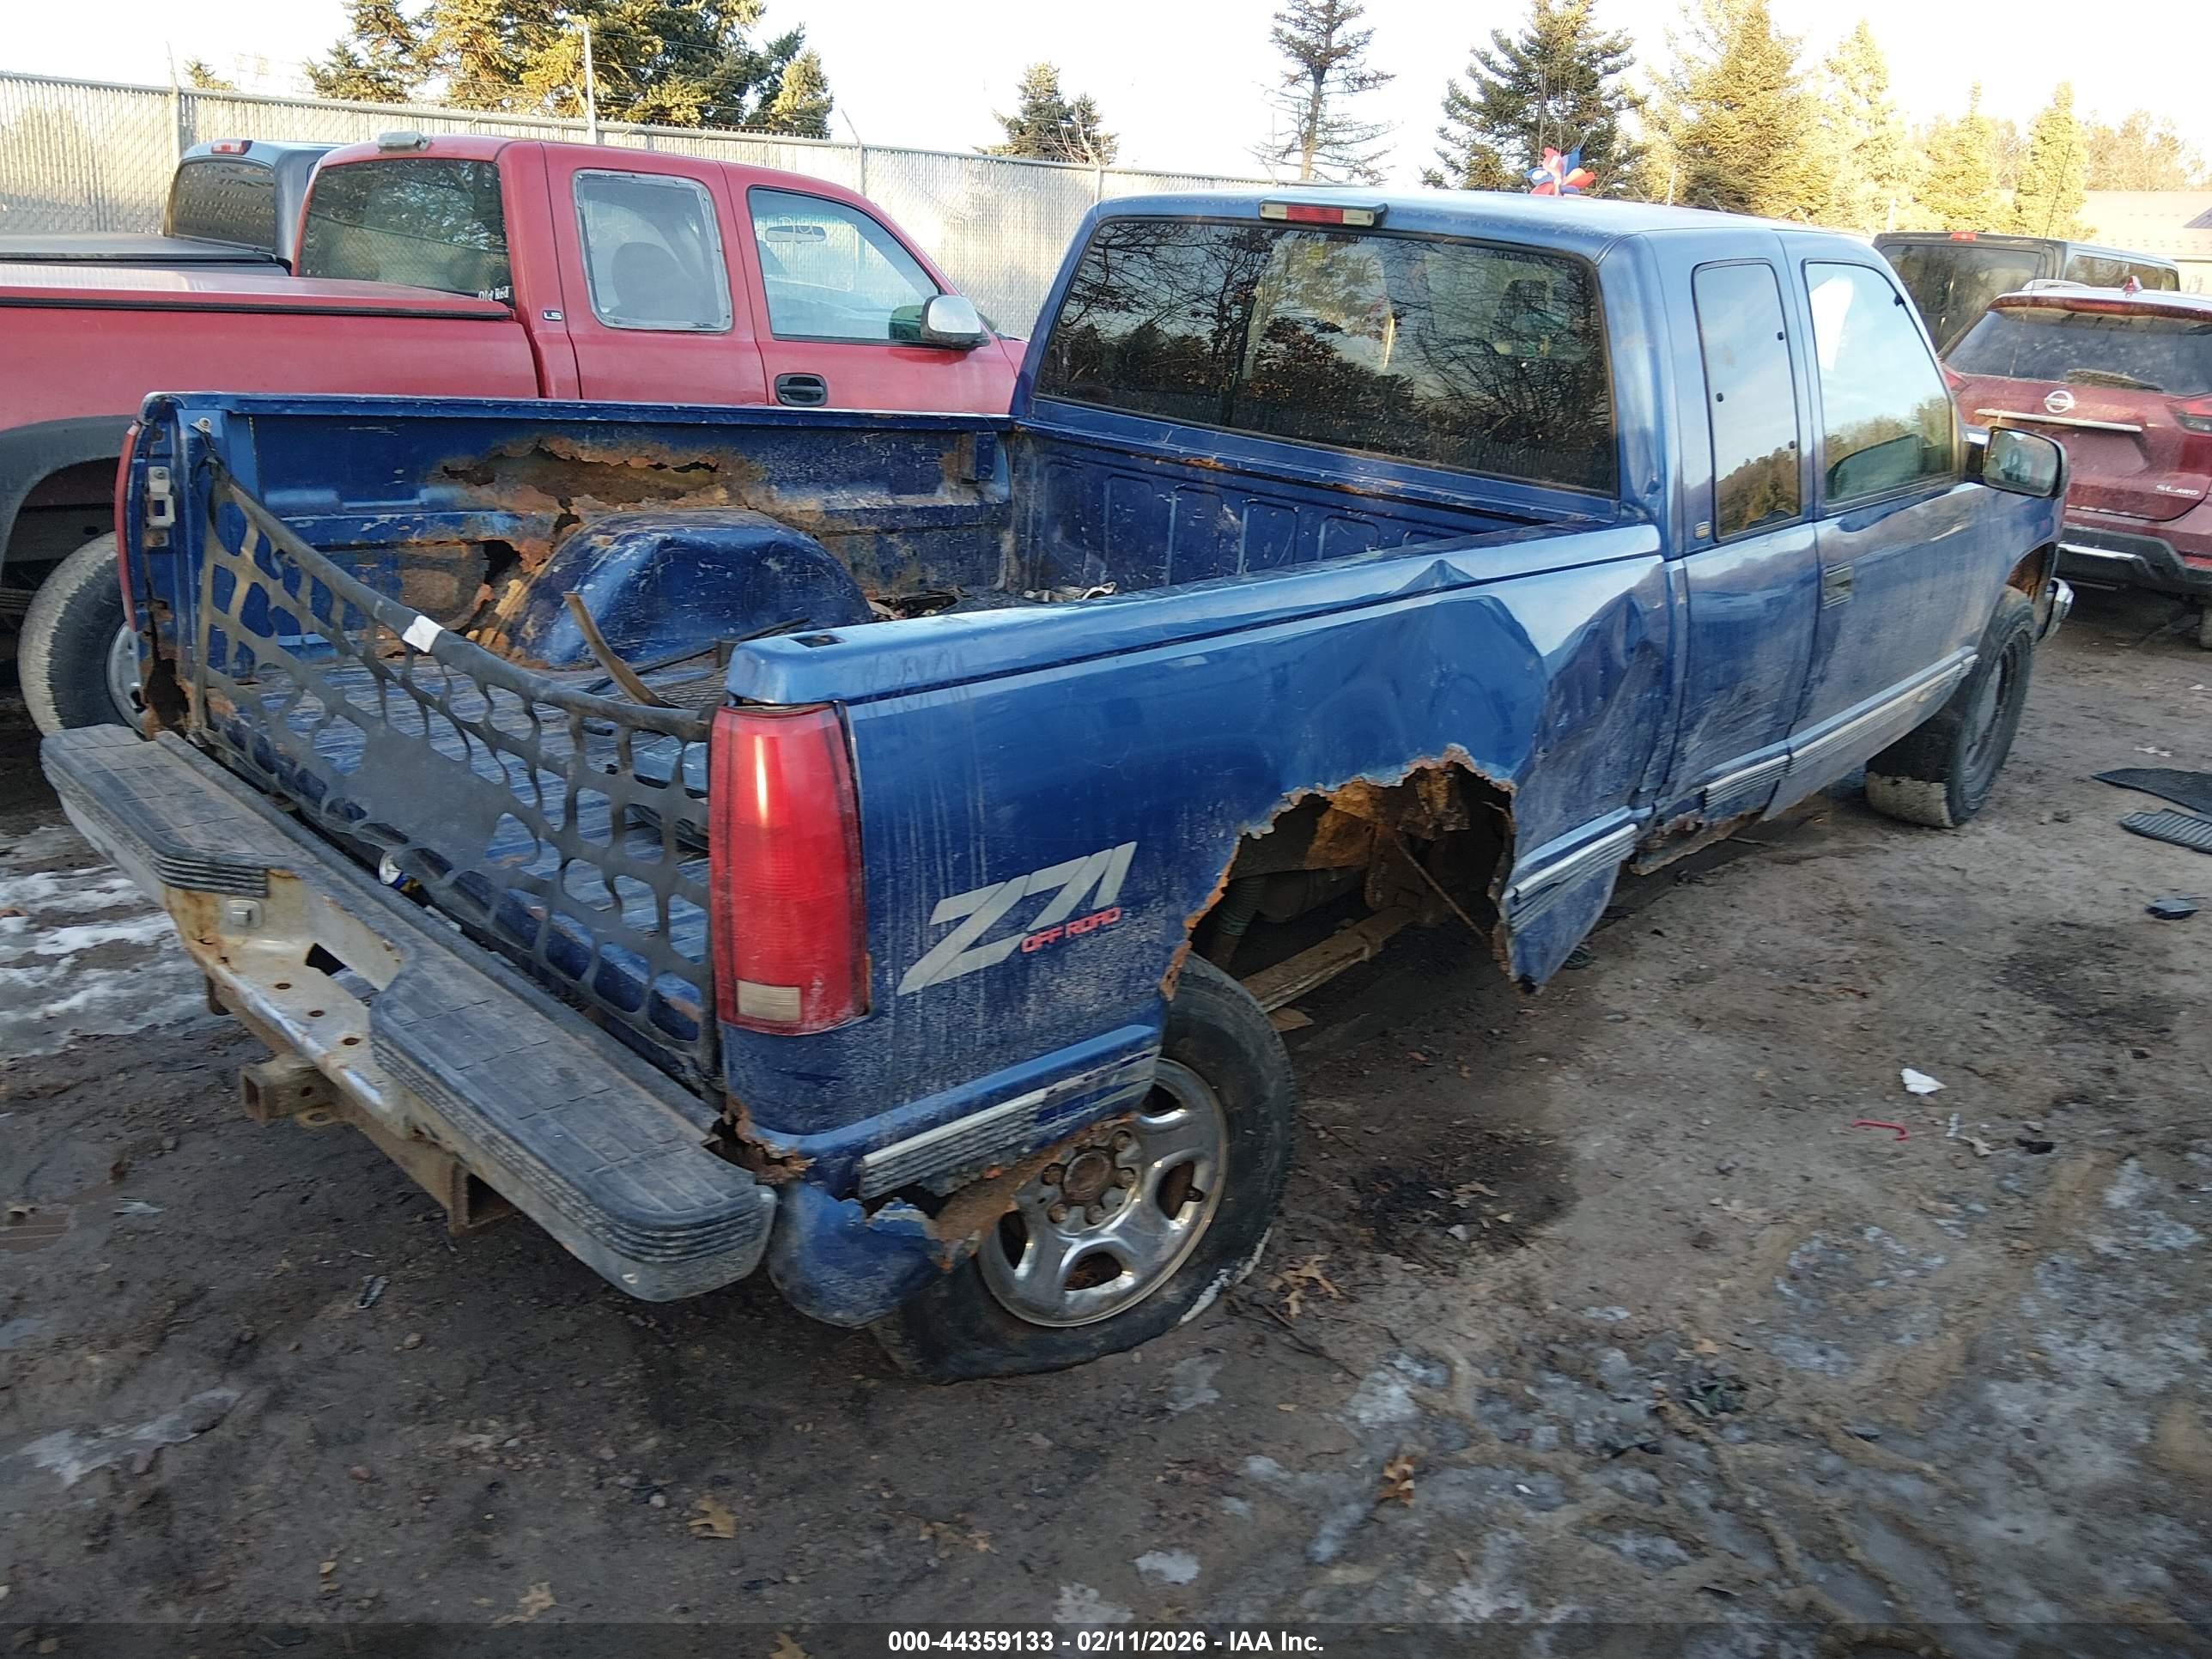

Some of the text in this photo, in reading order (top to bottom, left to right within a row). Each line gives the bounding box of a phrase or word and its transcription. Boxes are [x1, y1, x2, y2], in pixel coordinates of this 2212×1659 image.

[478, 286, 509, 301] Old Red
[544, 311, 562, 321] LS
[896, 841, 1137, 996] Z71
[1021, 906, 1121, 953] OFF ROAD
